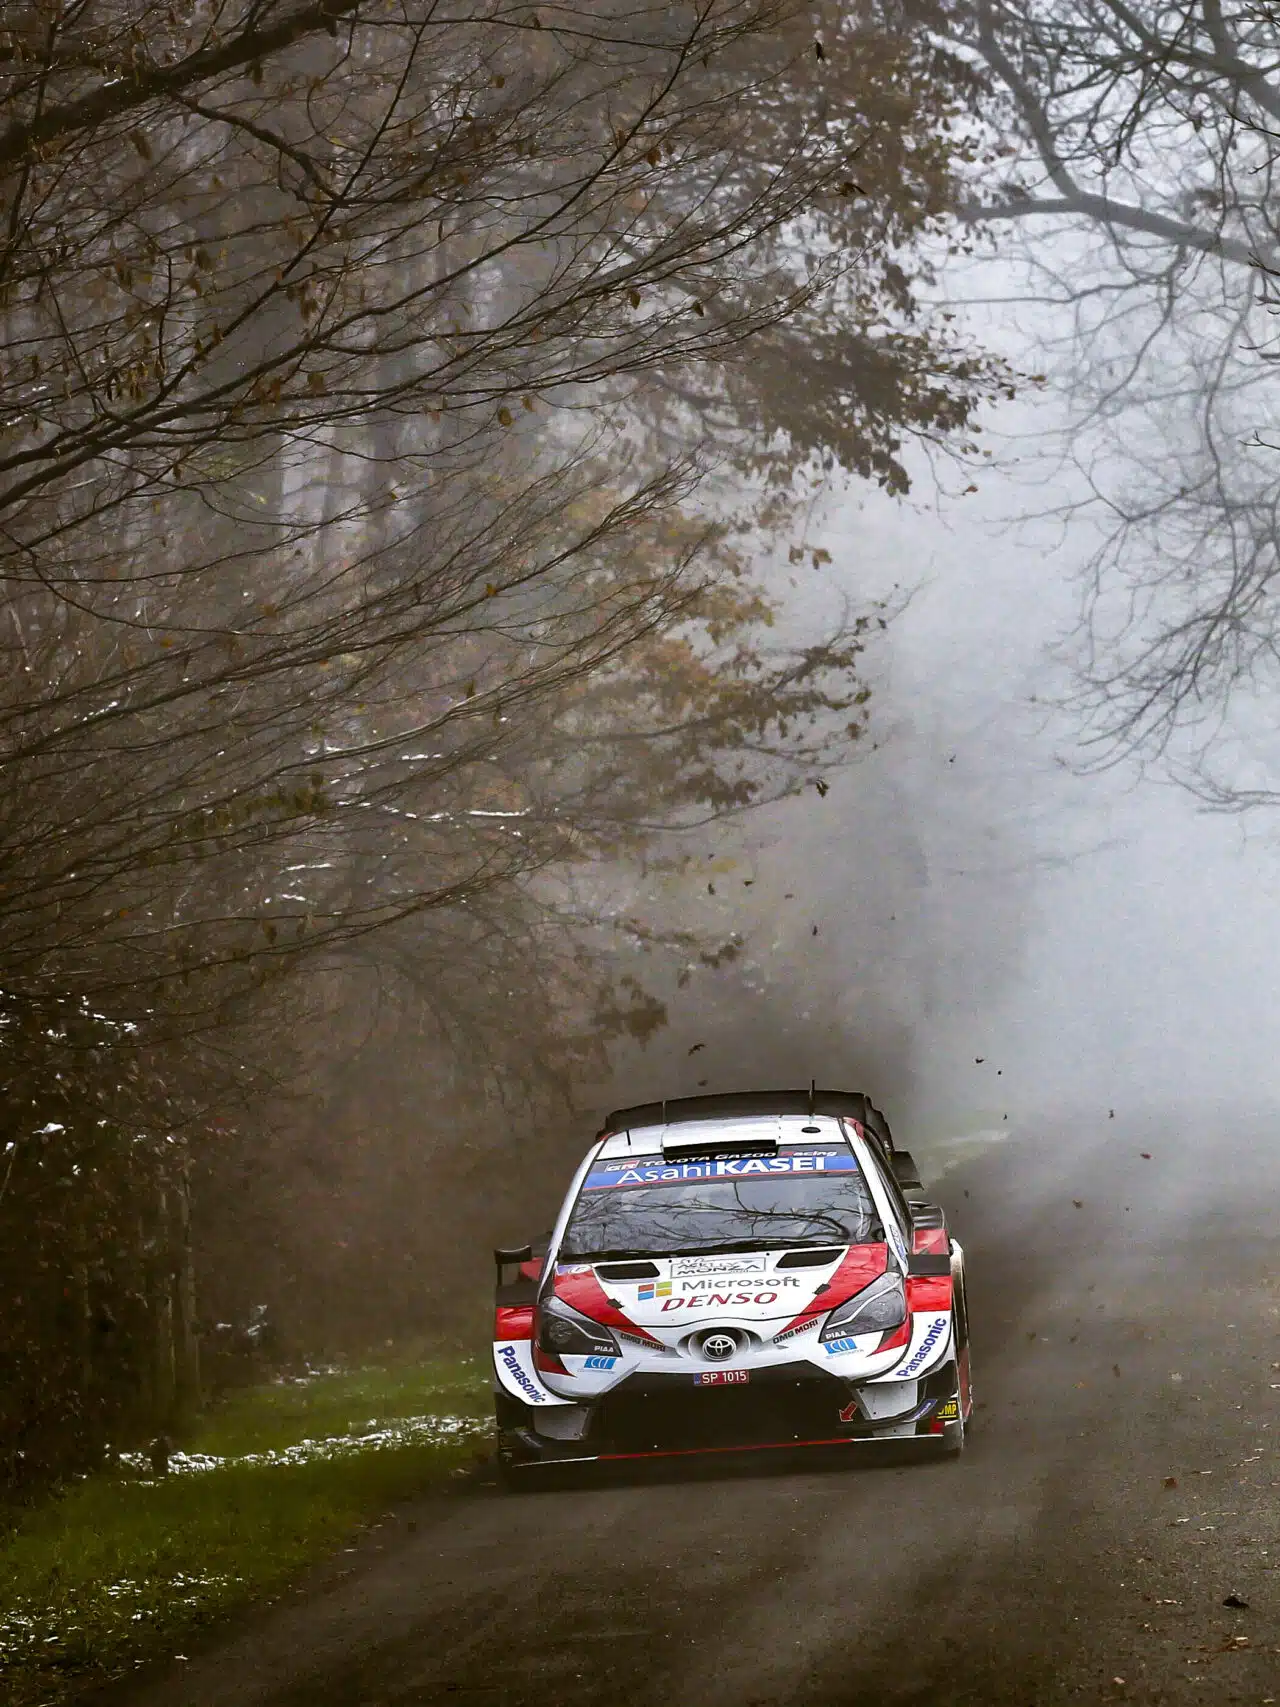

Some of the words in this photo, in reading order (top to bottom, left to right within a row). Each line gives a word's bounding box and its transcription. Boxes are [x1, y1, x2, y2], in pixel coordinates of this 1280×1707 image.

[643, 1156, 710, 1167] TOYOTA
[714, 1151, 777, 1160] GAZOO
[616, 1162, 711, 1184] Asahi
[716, 1157, 825, 1175] KASEI
[682, 1276, 800, 1291] Microsoft
[661, 1292, 778, 1312] DENSO
[794, 1319, 819, 1334] MORI
[825, 1330, 847, 1340] PIAA
[594, 1345, 614, 1353] PIAA
[896, 1318, 947, 1377] Panasonic
[497, 1345, 546, 1404] Panasonic
[702, 1373, 718, 1384] SP
[722, 1370, 747, 1382] 1015
